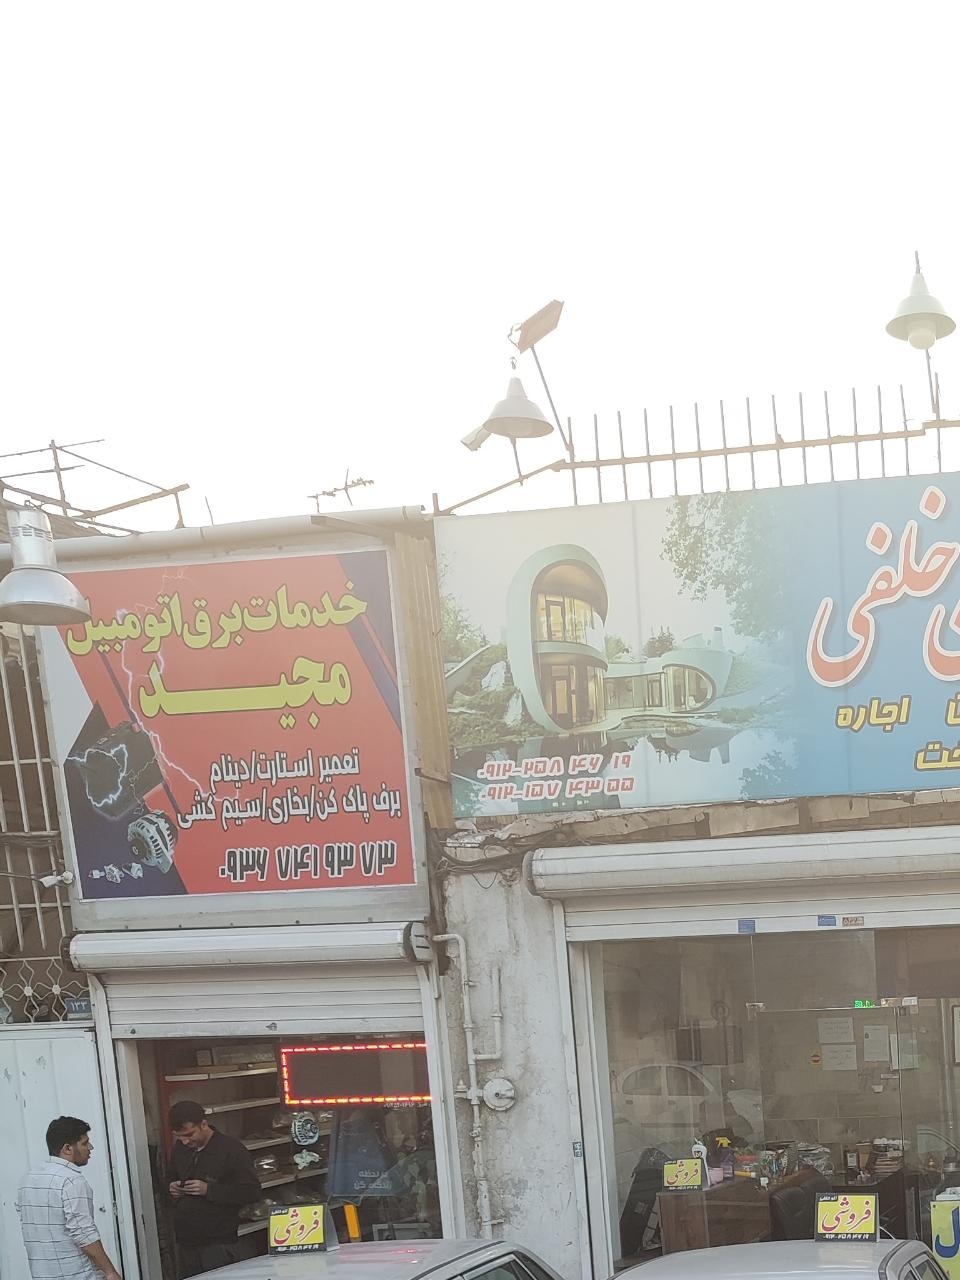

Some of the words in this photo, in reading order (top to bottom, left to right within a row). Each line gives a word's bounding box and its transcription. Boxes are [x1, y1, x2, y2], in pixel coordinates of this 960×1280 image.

[243, 580, 368, 631] خدمات
[806, 485, 960, 689] خلفی
[66, 591, 184, 656] اتومبیل
[182, 598, 245, 650] برق
[138, 655, 352, 730] مجید
[835, 694, 911, 733] اجاره
[318, 746, 360, 784] تعمیر
[569, 754, 603, 774] ۴۶
[612, 753, 633, 770] ۱۹
[341, 784, 370, 823] پاک
[371, 782, 402, 818] برف
[604, 776, 635, 795] ۵۵
[176, 788, 217, 830] کشی
[218, 846, 270, 883] ۰۹۳۶
[275, 844, 320, 881] ۷۴۱
[323, 842, 356, 879] ۹۳
[360, 840, 398, 878] ۷۳
[666, 1161, 699, 1185] فروشی
[273, 1208, 321, 1245] فروشی
[821, 1196, 873, 1233] فروشی
